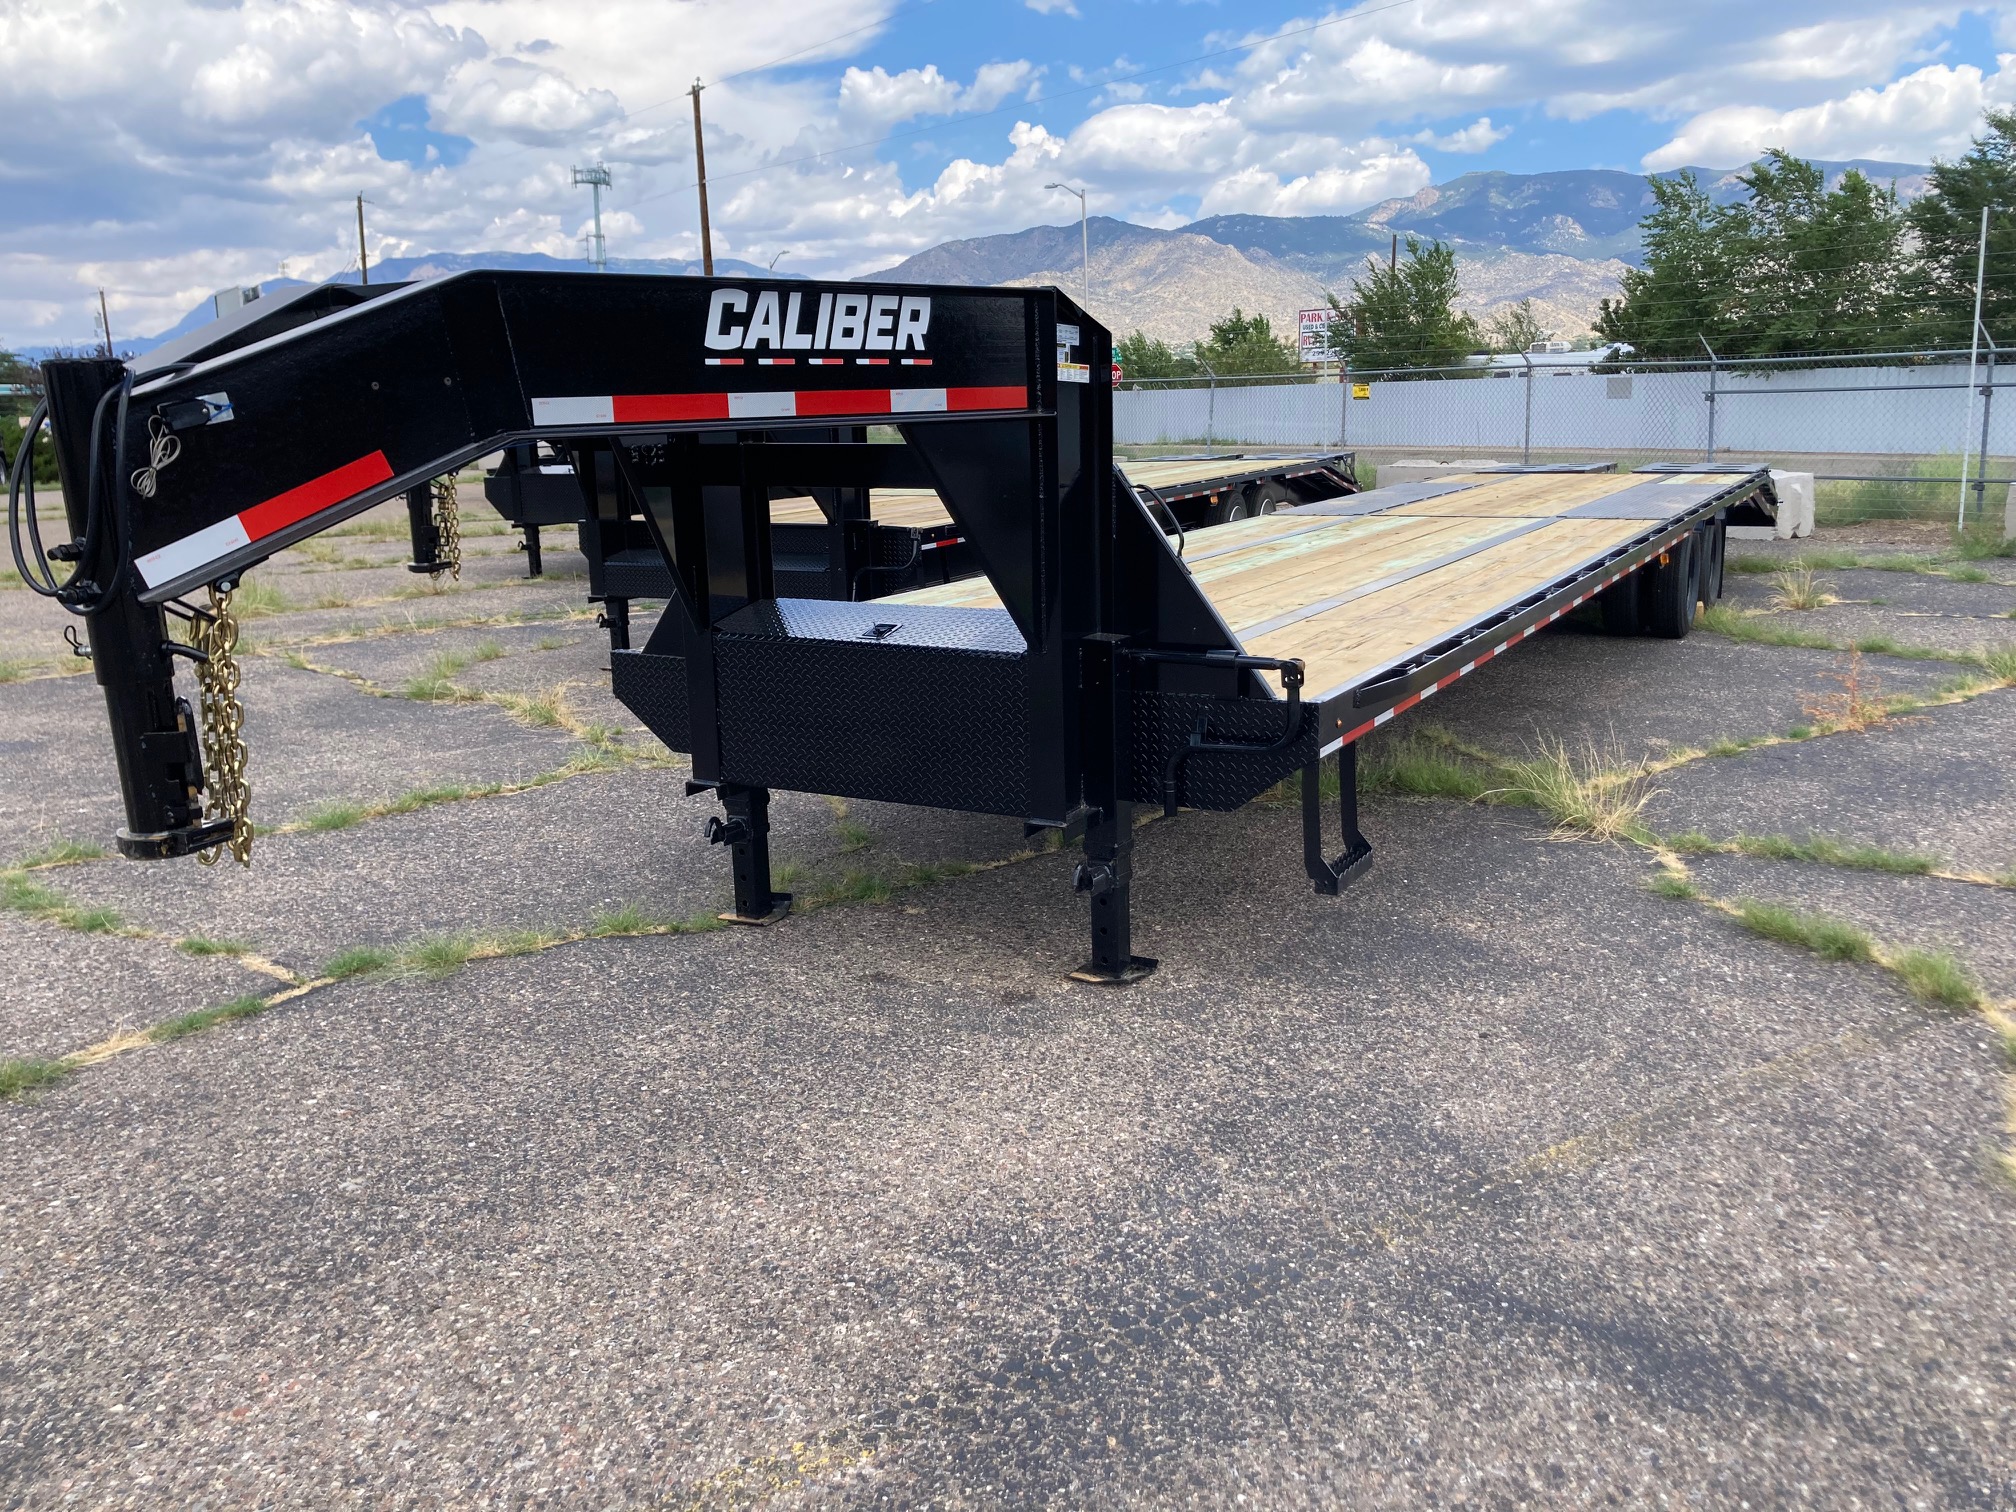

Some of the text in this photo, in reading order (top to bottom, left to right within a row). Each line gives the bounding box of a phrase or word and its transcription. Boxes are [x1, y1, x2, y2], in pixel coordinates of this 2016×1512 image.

[704, 288, 931, 350] CALIBER
[1300, 313, 1323, 323] PARK
[1112, 371, 1121, 379] OP
